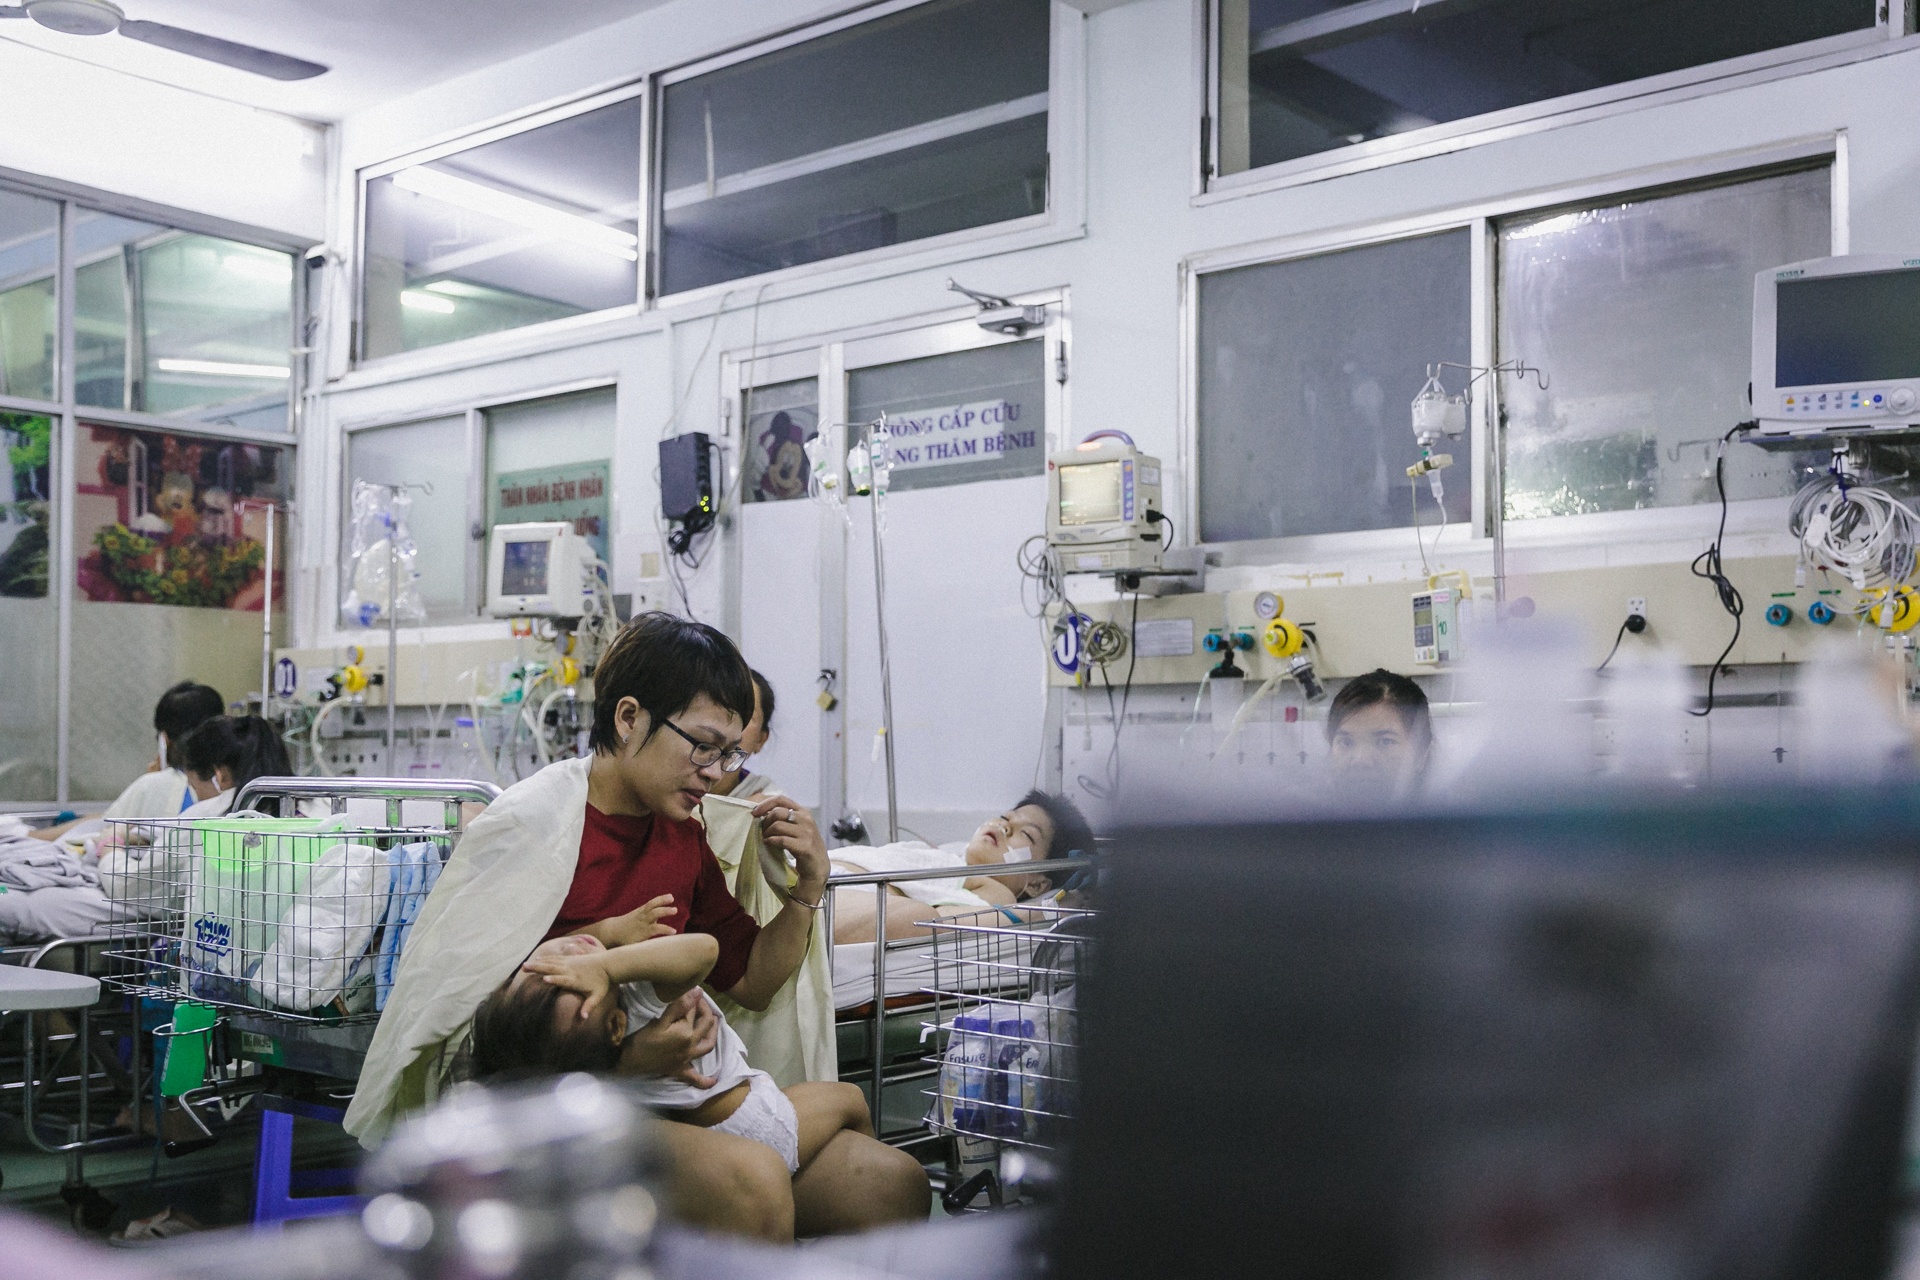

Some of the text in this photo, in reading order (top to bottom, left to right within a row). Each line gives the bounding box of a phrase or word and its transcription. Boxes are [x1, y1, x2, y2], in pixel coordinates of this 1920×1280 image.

[889, 401, 1020, 437] ÒNG CẤP CỨU
[984, 430, 1036, 456] BỆNH
[274, 662, 295, 694] 01
[203, 918, 231, 938] MINI
[949, 1052, 986, 1064] Ensure
